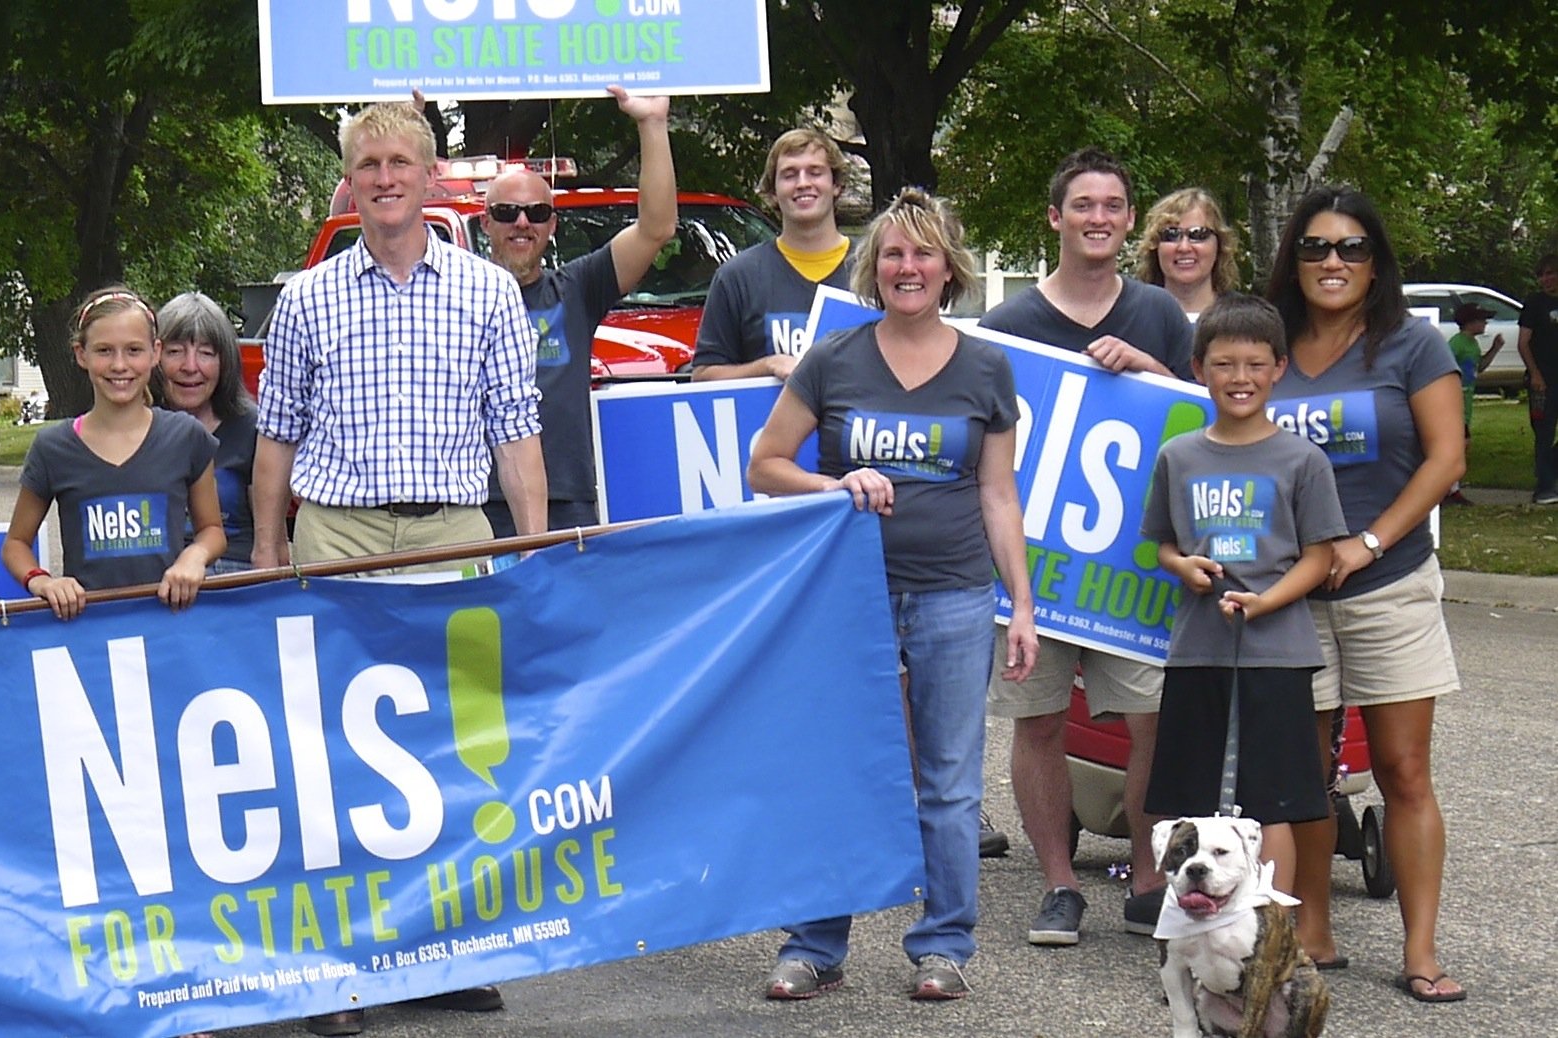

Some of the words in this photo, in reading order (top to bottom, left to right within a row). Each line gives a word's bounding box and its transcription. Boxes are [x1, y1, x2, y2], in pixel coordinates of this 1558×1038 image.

[346, 26, 420, 71] FOR
[432, 23, 545, 69] STATE
[558, 20, 684, 65] HOUSE
[849, 416, 942, 462] Nels!
[1345, 432, 1365, 441] COM
[87, 500, 150, 541] Nels!
[1192, 480, 1254, 521] Nels!
[1050, 609, 1068, 623] Box
[1093, 621, 1137, 643] Rochester,
[1139, 633, 1154, 646] MN
[31, 606, 516, 908] Nels!
[528, 775, 613, 836] COM
[65, 902, 182, 989] FOR
[210, 869, 398, 967] STATE
[426, 827, 623, 933] HOUSE
[138, 983, 189, 1009] Prepared
[191, 978, 213, 1000] and
[214, 975, 241, 997] Paid
[242, 972, 259, 992] for
[260, 970, 275, 991] by
[276, 967, 303, 987] Nels
[303, 963, 321, 983] for
[322, 960, 357, 981] House
[371, 954, 394, 973] P.O.
[396, 950, 418, 968] Box
[418, 942, 452, 963] 6363,
[451, 932, 513, 957] Rochester,
[512, 926, 534, 945] MN
[533, 917, 571, 941] 55903
